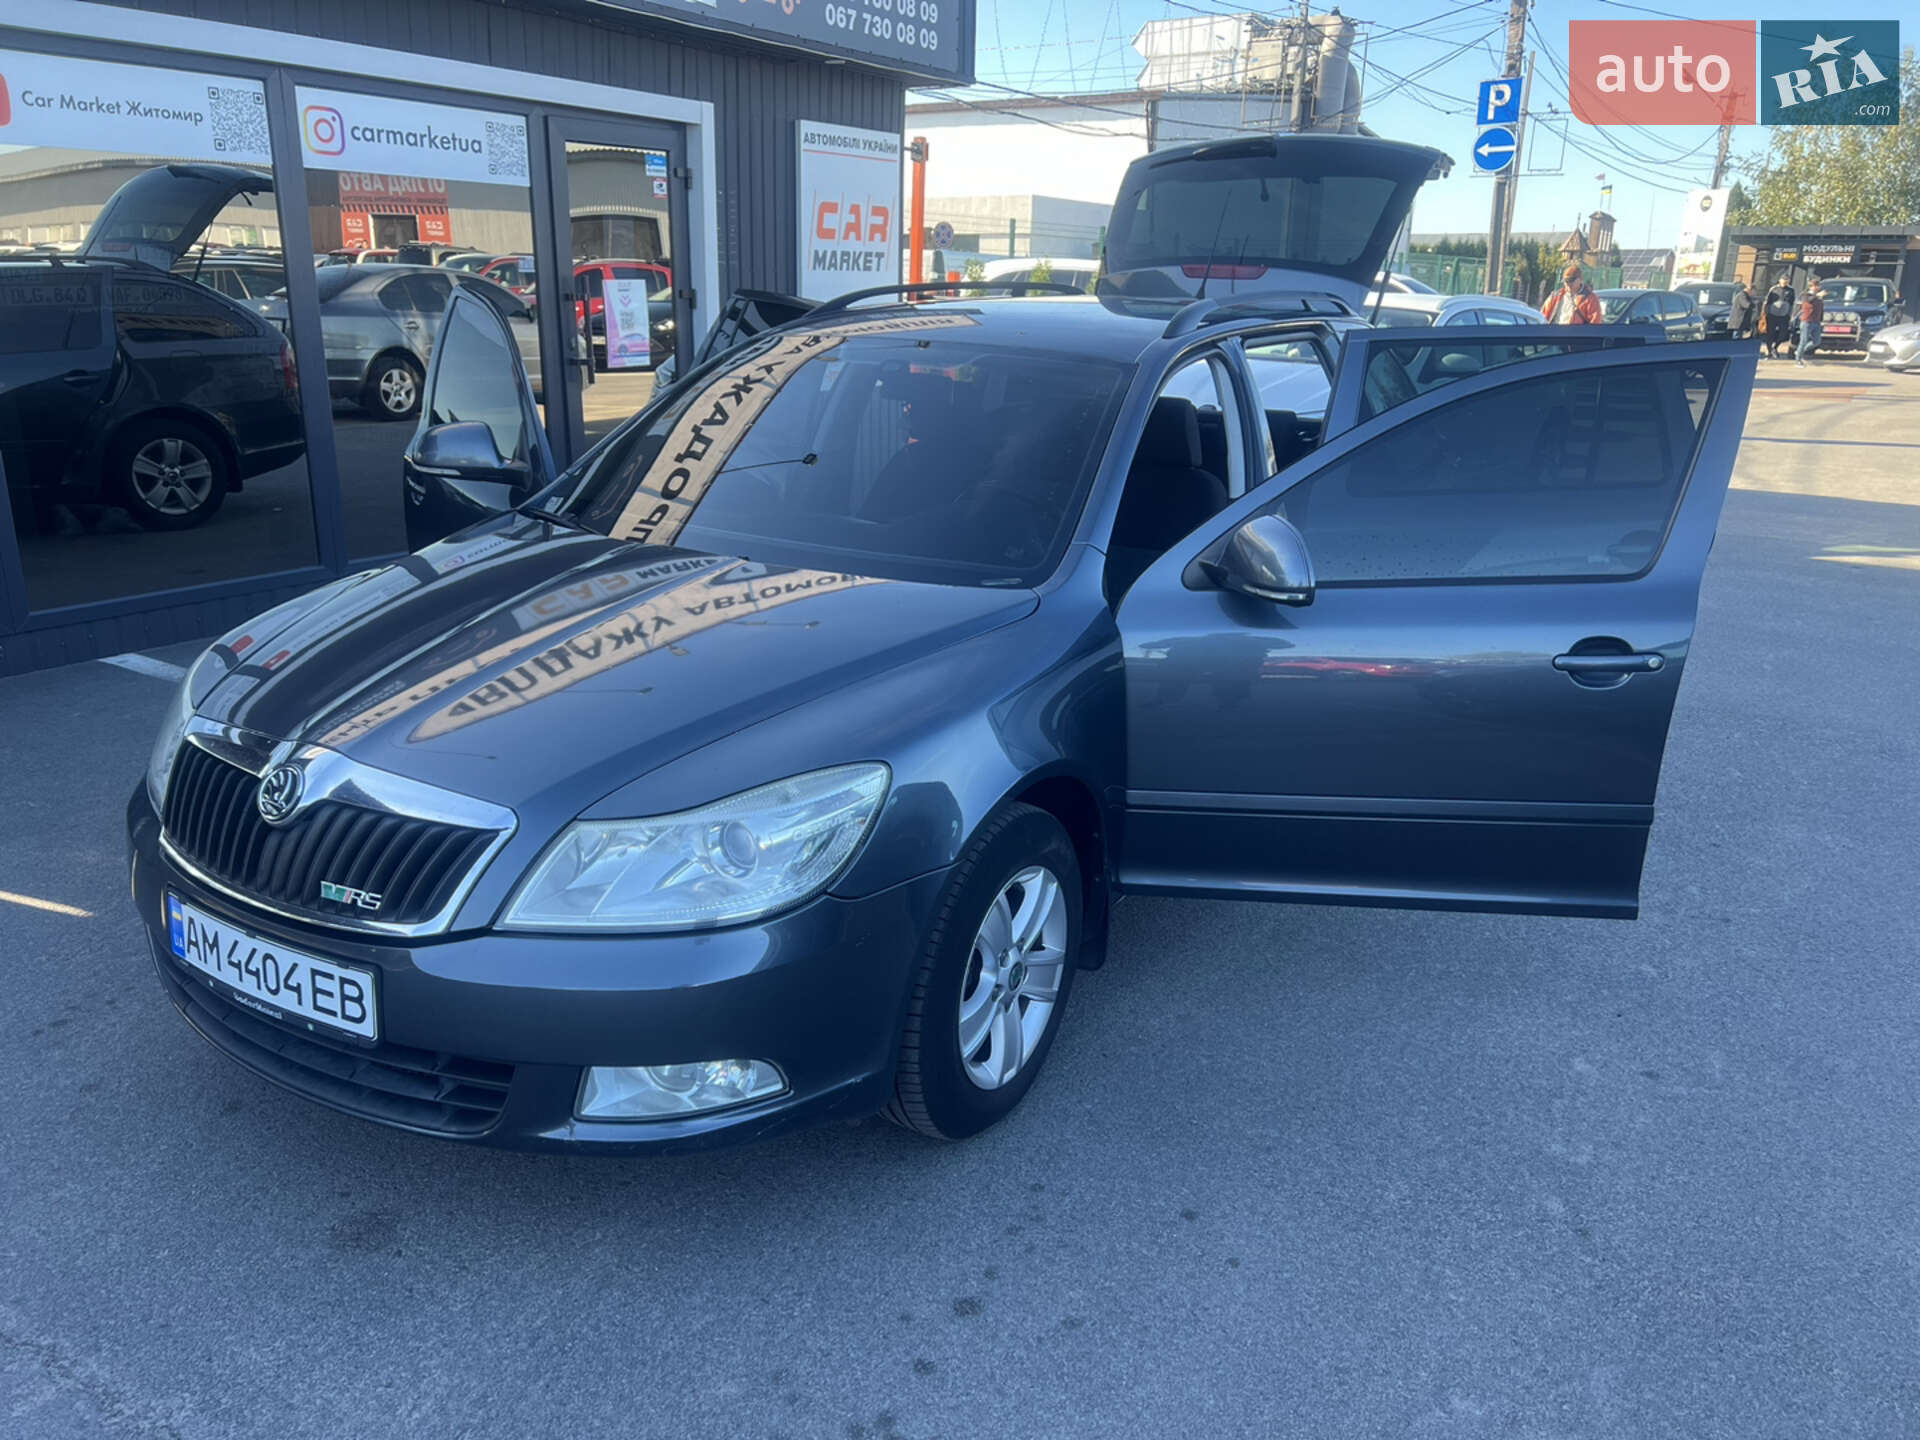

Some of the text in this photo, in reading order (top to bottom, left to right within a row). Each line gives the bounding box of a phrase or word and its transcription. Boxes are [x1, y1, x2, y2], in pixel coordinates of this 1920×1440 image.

[825, 4, 857, 30] 067
[862, 13, 892, 39] 730
[896, 22, 916, 45] 08
[919, 30, 938, 51] 09
[919, 3, 938, 23] 09
[22, 90, 204, 126] Car Market Житомир
[1487, 83, 1512, 121] P
[351, 125, 483, 154] carmarketua
[803, 131, 898, 154] АВТОМОБІЛІ УКРАЇНИ
[816, 201, 890, 243] CAR
[812, 250, 885, 273] MARKET
[227, 939, 303, 1007] 4404
[310, 967, 367, 1025] EB
